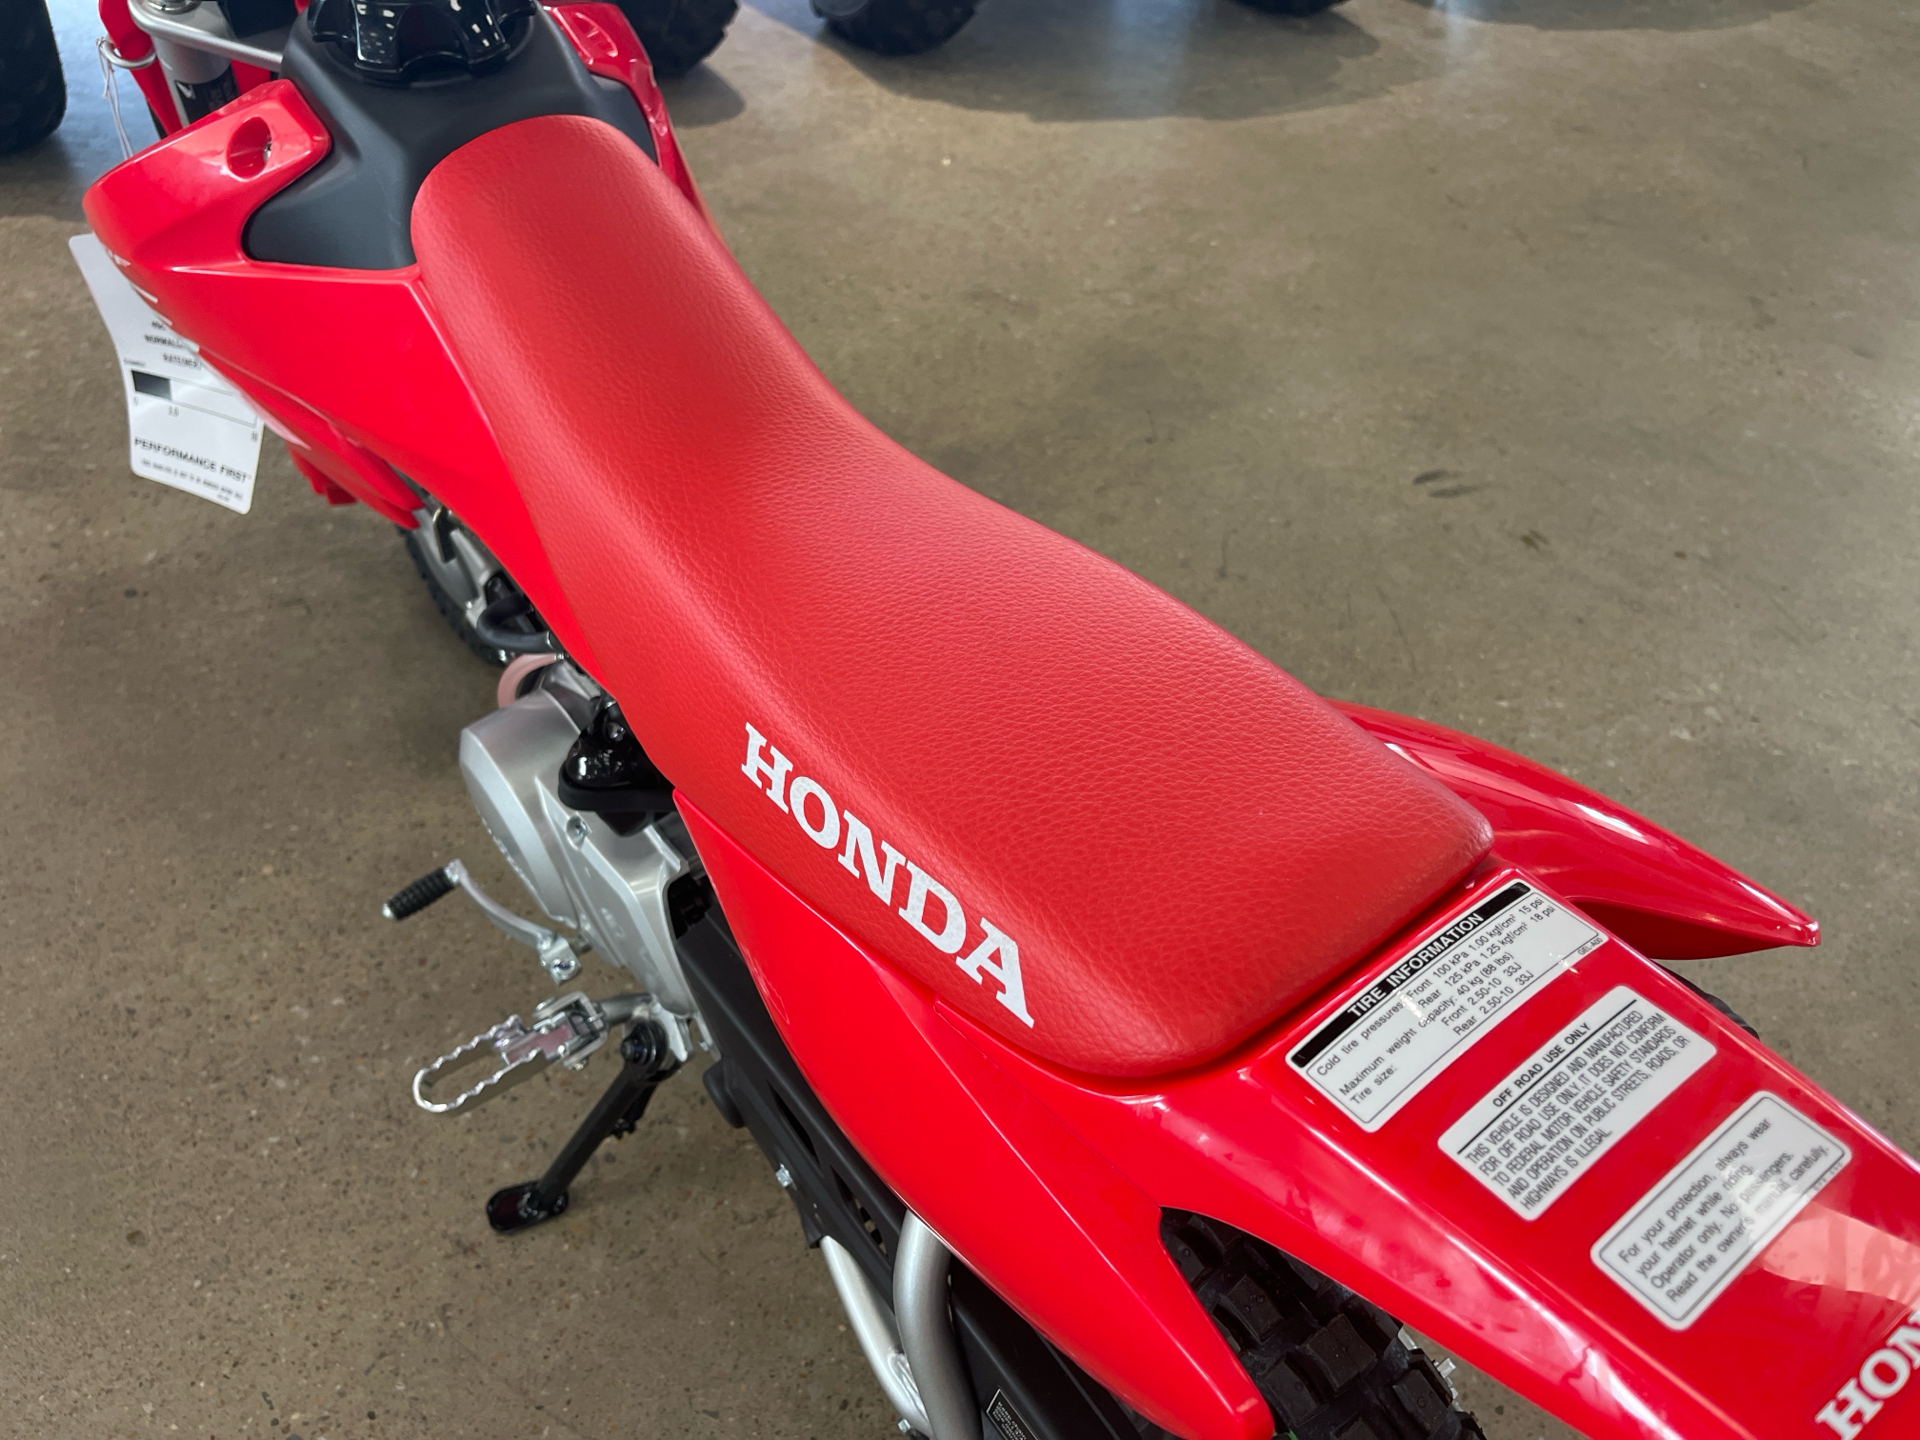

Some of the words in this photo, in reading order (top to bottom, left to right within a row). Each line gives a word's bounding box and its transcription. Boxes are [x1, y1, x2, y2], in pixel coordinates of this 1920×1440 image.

[134, 436, 217, 472] PERFORMANCE
[219, 463, 249, 484] FIRST
[742, 721, 1034, 1028] HONDA
[1316, 1054, 1341, 1076] Cold
[1341, 1040, 1359, 1054] tire
[1406, 978, 1433, 998] Front
[1433, 963, 1452, 978] 100
[1448, 951, 1470, 966] kPa
[1468, 935, 1490, 951] 1.00
[1518, 905, 1532, 915] 15
[1530, 898, 1544, 910] psi
[1339, 1056, 1385, 1096] Maximum
[1386, 1028, 1417, 1054] weight
[1457, 984, 1470, 996] 40
[1467, 976, 1484, 987] kg
[1480, 964, 1497, 978] (88
[1493, 952, 1514, 966] lbs)
[1347, 986, 1386, 1017] TIRE
[1386, 912, 1484, 988] INFORMATION
[1417, 989, 1441, 1008] Rear
[1444, 972, 1464, 986] 125
[1460, 960, 1481, 974] kPa
[1480, 943, 1501, 959] 1.25
[1530, 913, 1544, 922] 18
[1542, 906, 1556, 917] psi
[1452, 1016, 1477, 1036] Rear
[1479, 986, 1514, 1015] 2.50-10
[1350, 1087, 1372, 1104] Tire
[1374, 1065, 1397, 1086] size:
[1441, 1005, 1468, 1026] Front
[1467, 977, 1502, 1006] 2.50-10
[1465, 1143, 1490, 1164] THIS
[1484, 1112, 1523, 1145] VEHICLE
[1518, 1104, 1533, 1116] IS
[1528, 1071, 1570, 1108] DESIGNED
[1566, 1056, 1588, 1075] AND
[1583, 1010, 1643, 1060] MANUFACTURED
[1478, 1156, 1502, 1176] FOR
[1498, 1139, 1516, 1158] OFF
[1513, 1118, 1542, 1143] ROAD
[1538, 1102, 1561, 1121] USE
[1587, 1055, 1614, 1078] DOES
[1609, 1040, 1630, 1058] NOT
[1626, 1012, 1666, 1044] CONFORM
[1491, 1171, 1510, 1186] TO
[1506, 1140, 1546, 1174] FEDERAL
[1540, 1112, 1575, 1142] MOTOR
[1570, 1083, 1607, 1114] VEHICLE
[1602, 1060, 1633, 1087] SAFETY
[1629, 1025, 1676, 1064] STANDARDS
[1492, 1088, 1512, 1107] OFF
[1514, 1063, 1543, 1089] ROAD
[1542, 1045, 1566, 1063] USE
[1564, 1022, 1590, 1045] ONLY
[1507, 1177, 1530, 1199] AND
[1526, 1135, 1575, 1180] OPERATION
[1570, 1123, 1588, 1138] ON
[1582, 1098, 1616, 1126] PUBLIC
[1611, 1069, 1652, 1101] STREETS,
[1644, 1046, 1679, 1072] ROADS,
[1672, 1035, 1690, 1048] OR
[1520, 1165, 1568, 1210] HIGHWAYS
[1564, 1155, 1579, 1168] IS
[1618, 1243, 1641, 1263] For
[1641, 1218, 1666, 1245] your
[1666, 1174, 1717, 1221] protection,
[1715, 1140, 1749, 1171] always
[1748, 1119, 1770, 1140] wear
[1636, 1250, 1661, 1279] your
[1659, 1216, 1697, 1251] helmet
[1696, 1192, 1722, 1216] while
[1650, 1244, 1697, 1289] Operator
[1697, 1222, 1723, 1244] only.
[1720, 1202, 1739, 1219] No
[1739, 1151, 1794, 1204] passengers.
[1666, 1271, 1698, 1302] Read
[1696, 1254, 1717, 1272] the
[1716, 1215, 1755, 1253] owner's
[1789, 1145, 1830, 1181] carefully.
